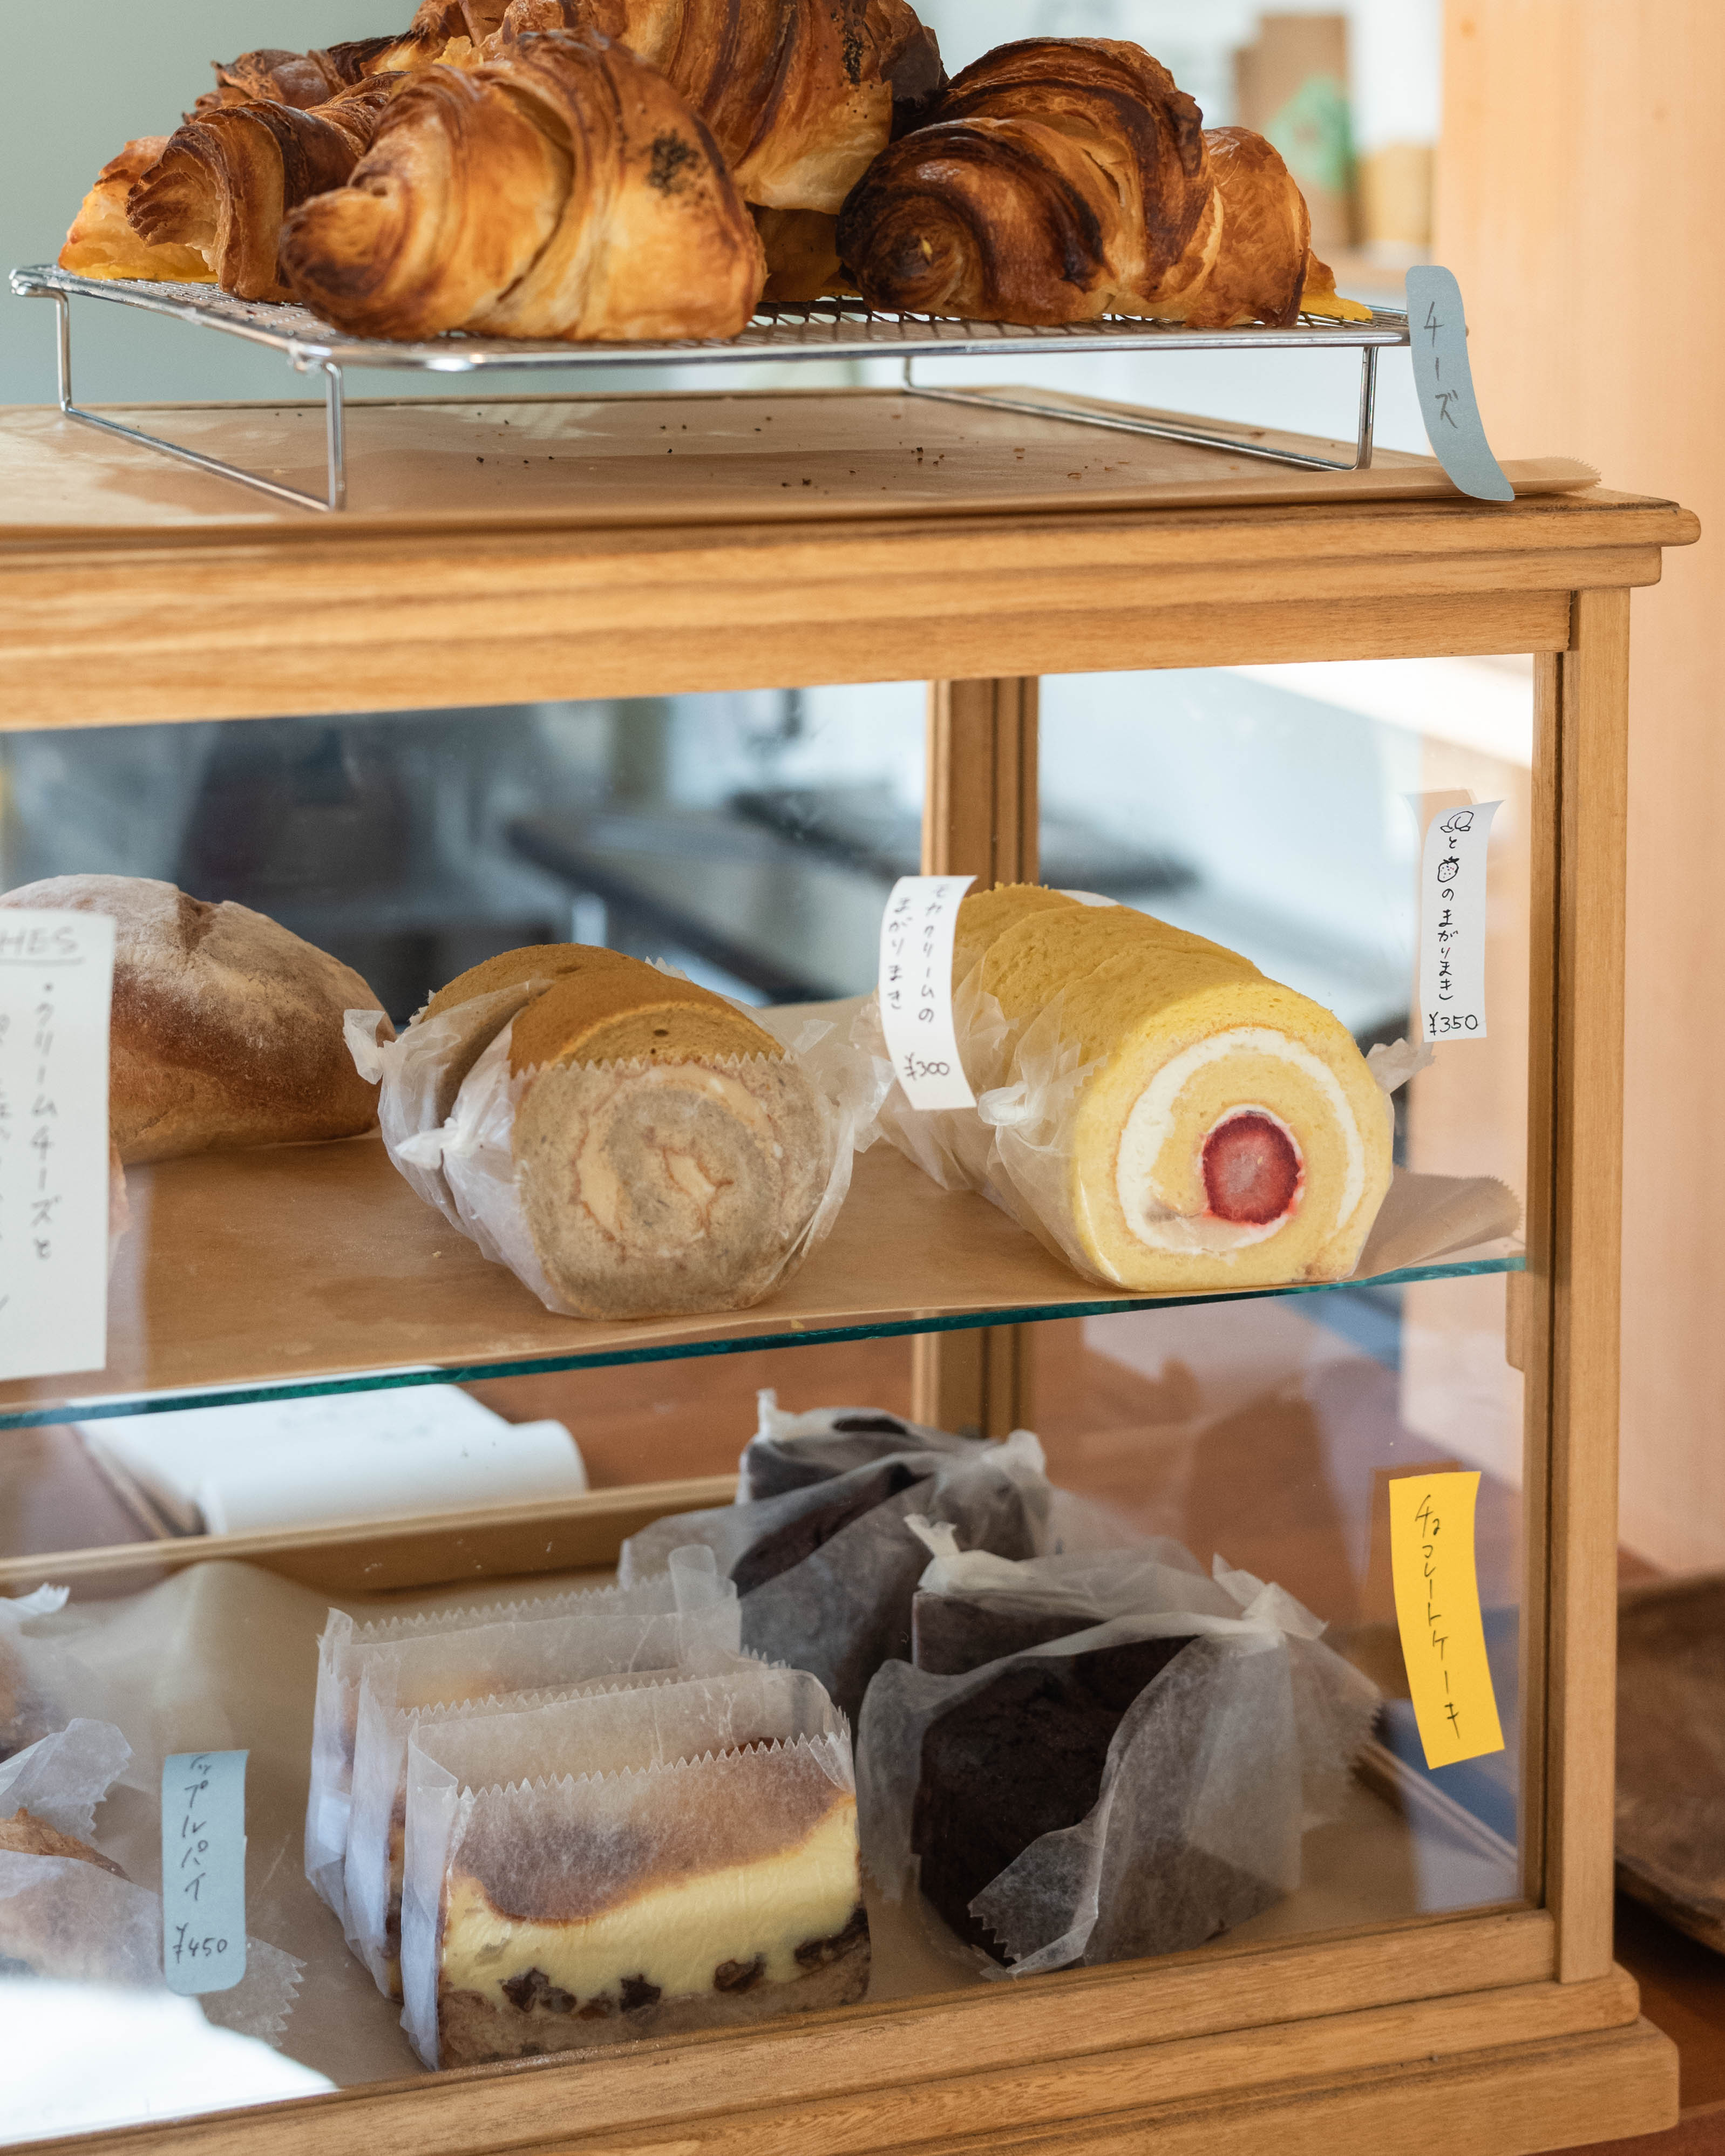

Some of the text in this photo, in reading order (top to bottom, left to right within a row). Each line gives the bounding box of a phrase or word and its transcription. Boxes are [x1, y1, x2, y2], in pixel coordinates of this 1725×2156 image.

[1423, 301, 1459, 429] チーズ
[887, 897, 913, 1010] まがりまき
[1428, 1011, 1478, 1036] ¥350
[904, 1051, 951, 1081] ¥300
[1414, 1493, 1460, 1739] チョコレートケーキ
[173, 1922, 228, 1964] ¥450
